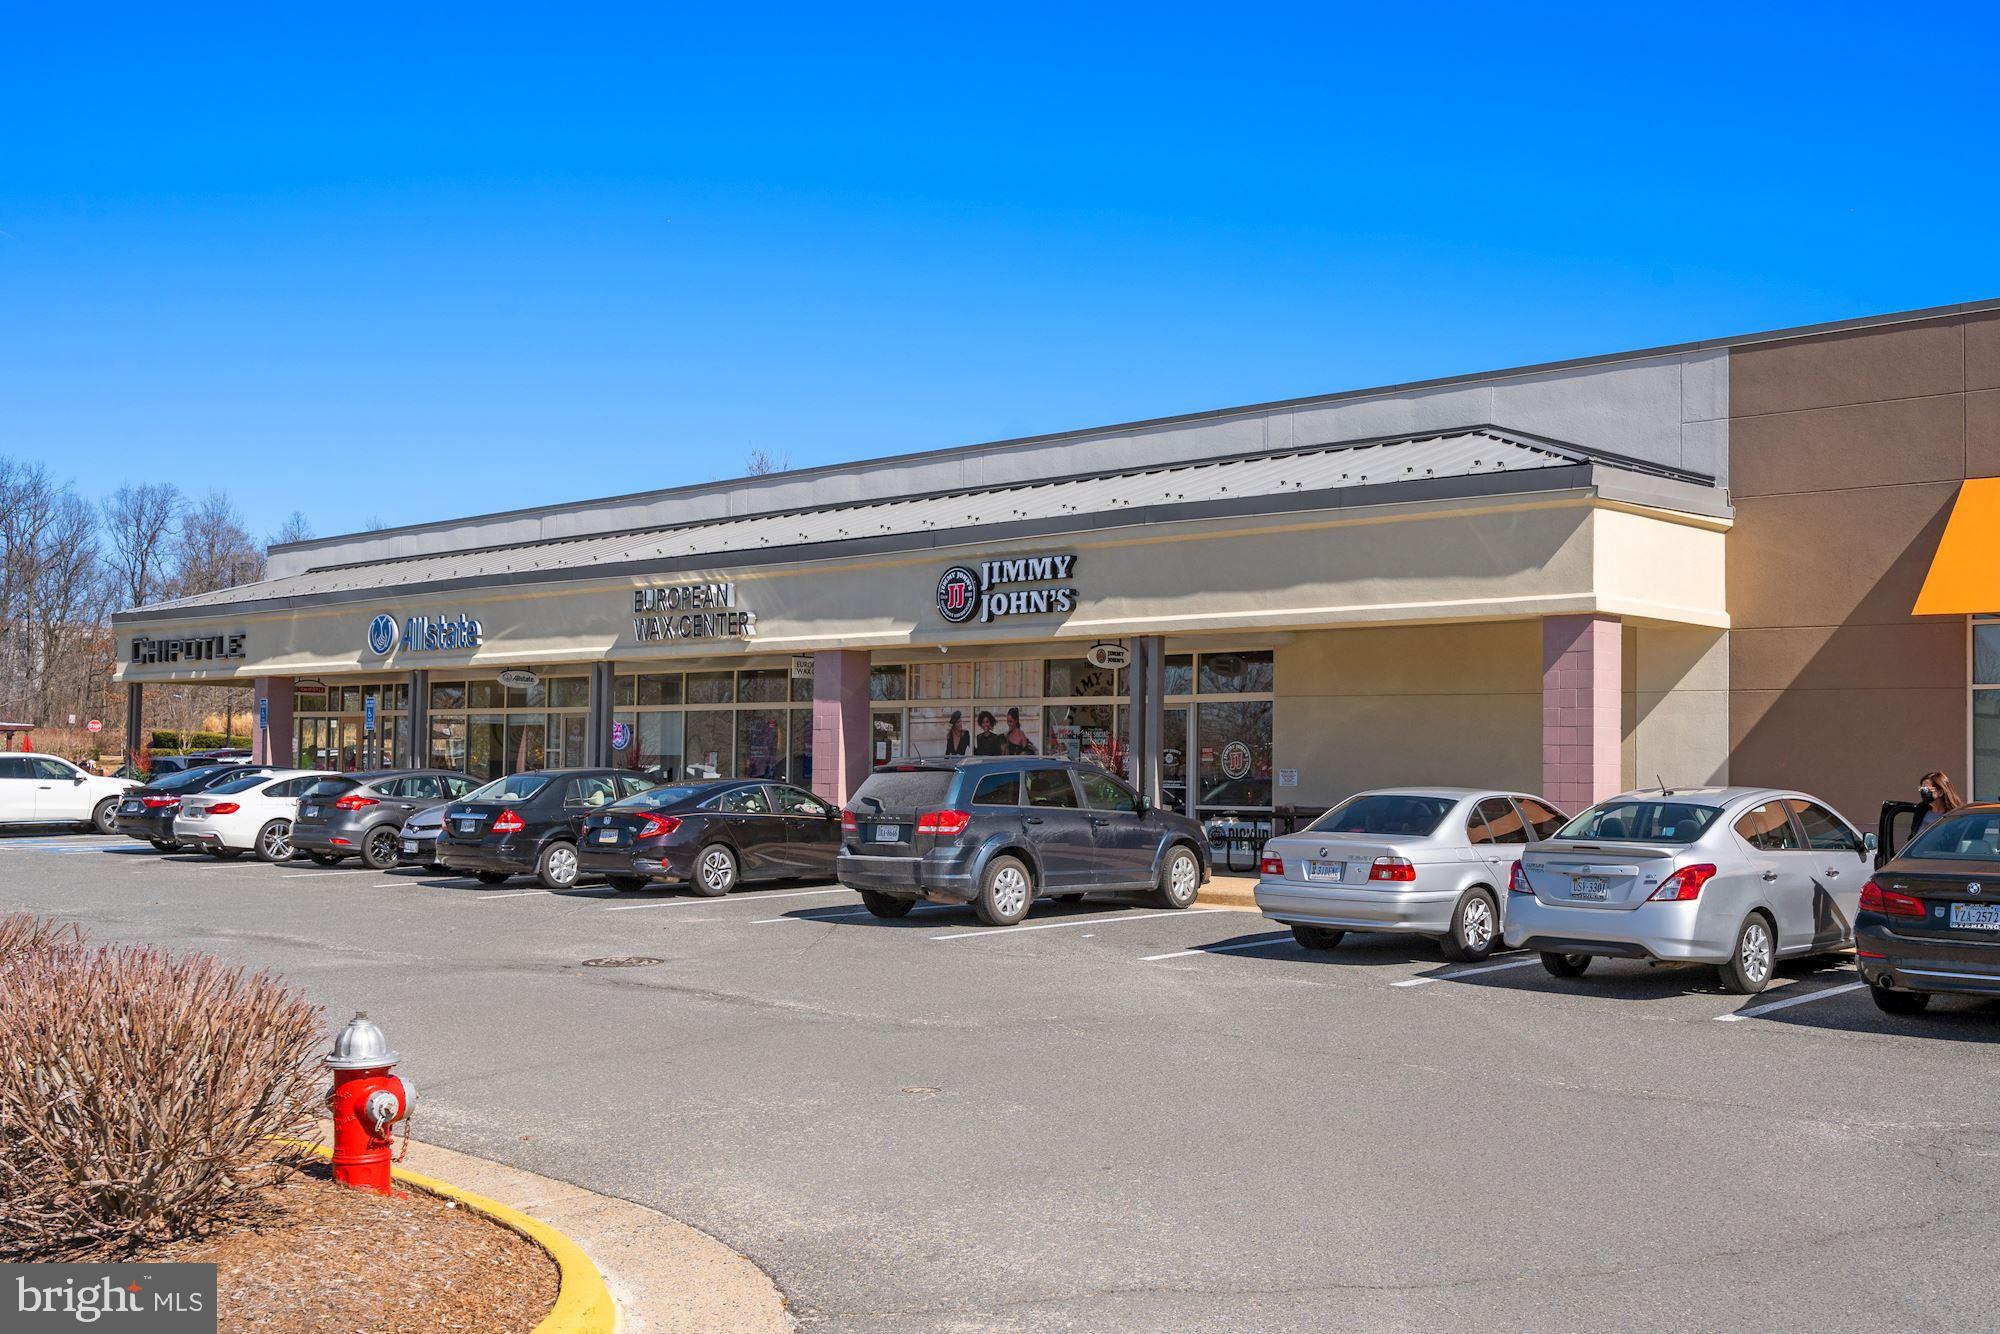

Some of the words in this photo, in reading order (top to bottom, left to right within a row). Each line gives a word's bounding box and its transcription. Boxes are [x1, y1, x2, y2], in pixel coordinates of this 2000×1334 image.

[940, 571, 956, 594] JIMMY
[981, 555, 1076, 591] JIMMY
[634, 583, 734, 613] EUROPEAN
[947, 582, 965, 609] JJ
[980, 589, 1077, 623] JOHN'S
[400, 614, 482, 651] Allstate
[634, 616, 675, 641] WAX
[678, 611, 757, 638] CENTER
[131, 634, 246, 664] CHIPOTLE
[1952, 922, 2000, 930] STERLING
[1954, 909, 1999, 923] VZA-2572
